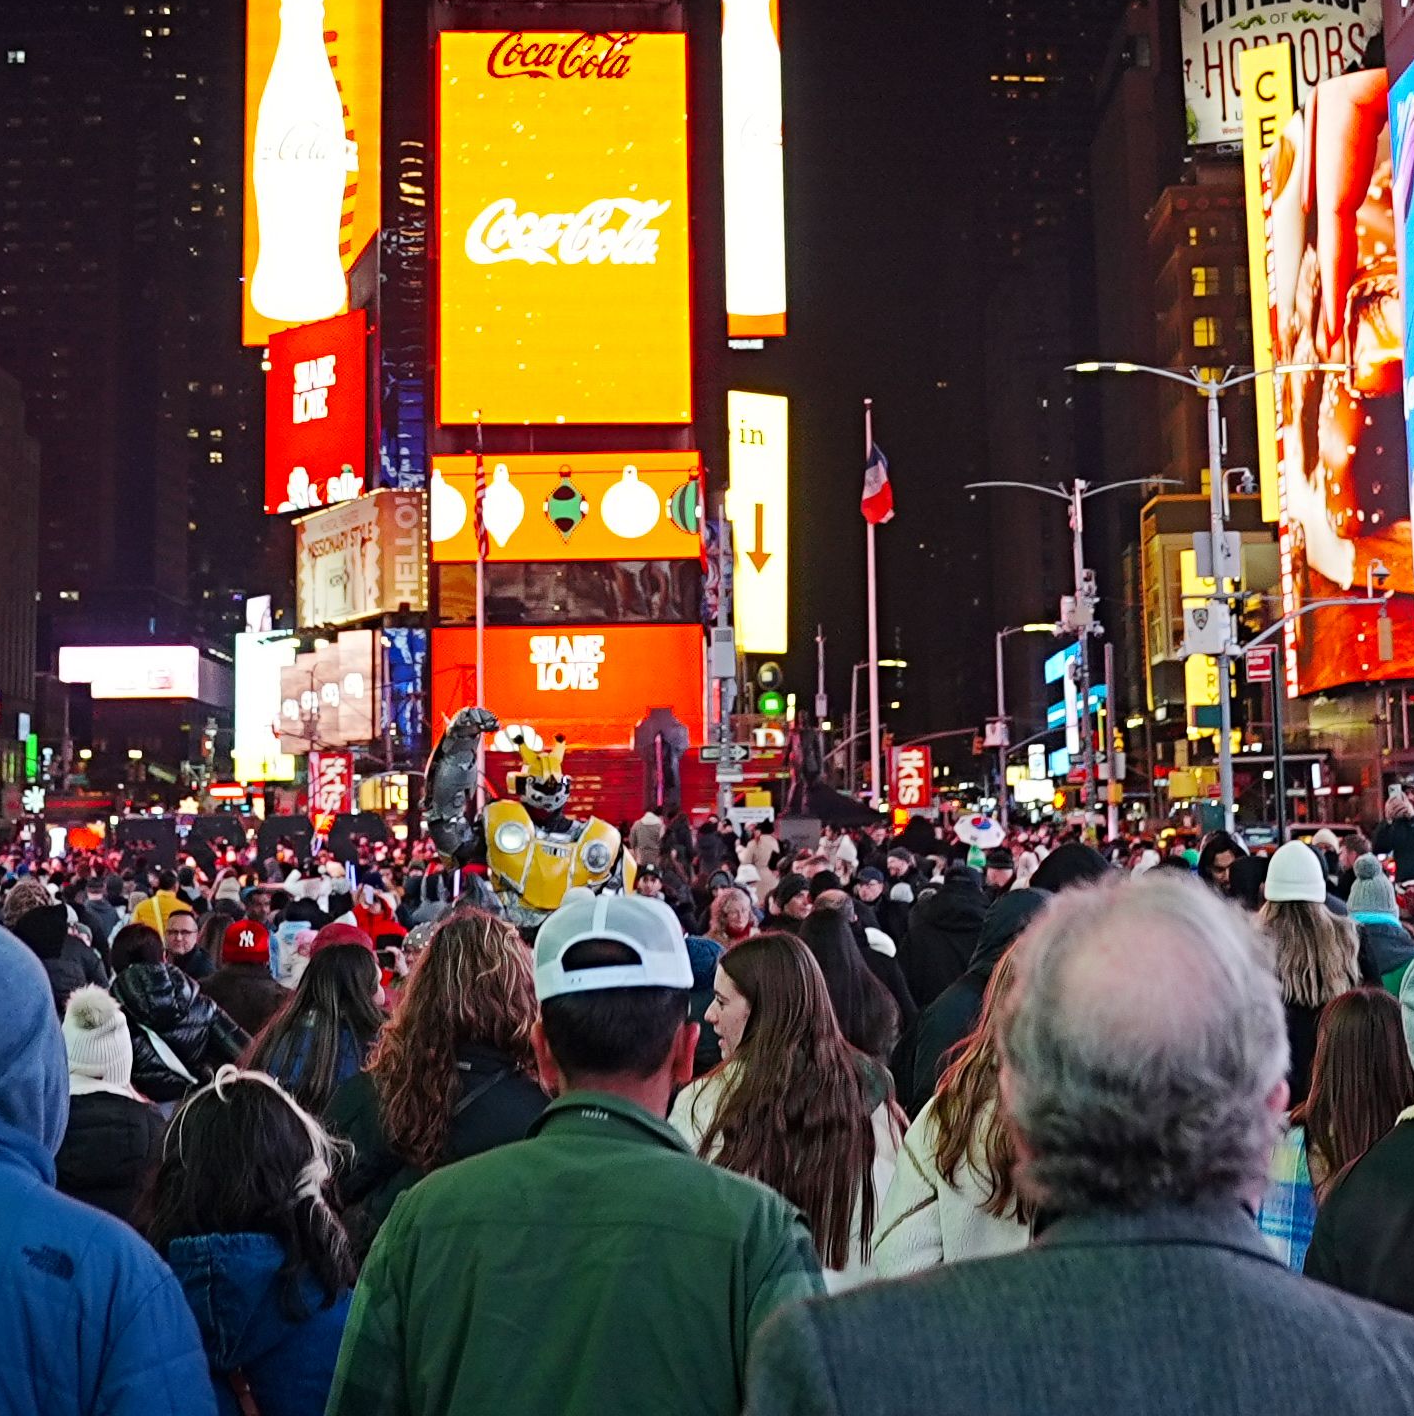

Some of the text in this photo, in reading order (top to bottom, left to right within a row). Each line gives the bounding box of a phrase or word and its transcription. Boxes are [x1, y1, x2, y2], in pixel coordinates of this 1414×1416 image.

[487, 32, 639, 79] Coca-Cola
[1204, 23, 1364, 121] HOORS
[465, 197, 672, 265] Coca-Cola
[294, 354, 337, 394] SHARE
[293, 387, 328, 424] LOVE
[394, 497, 418, 604] HELLO!
[529, 635, 605, 664] SHARE
[537, 662, 599, 690] LOVE
[898, 749, 925, 805] tkts
